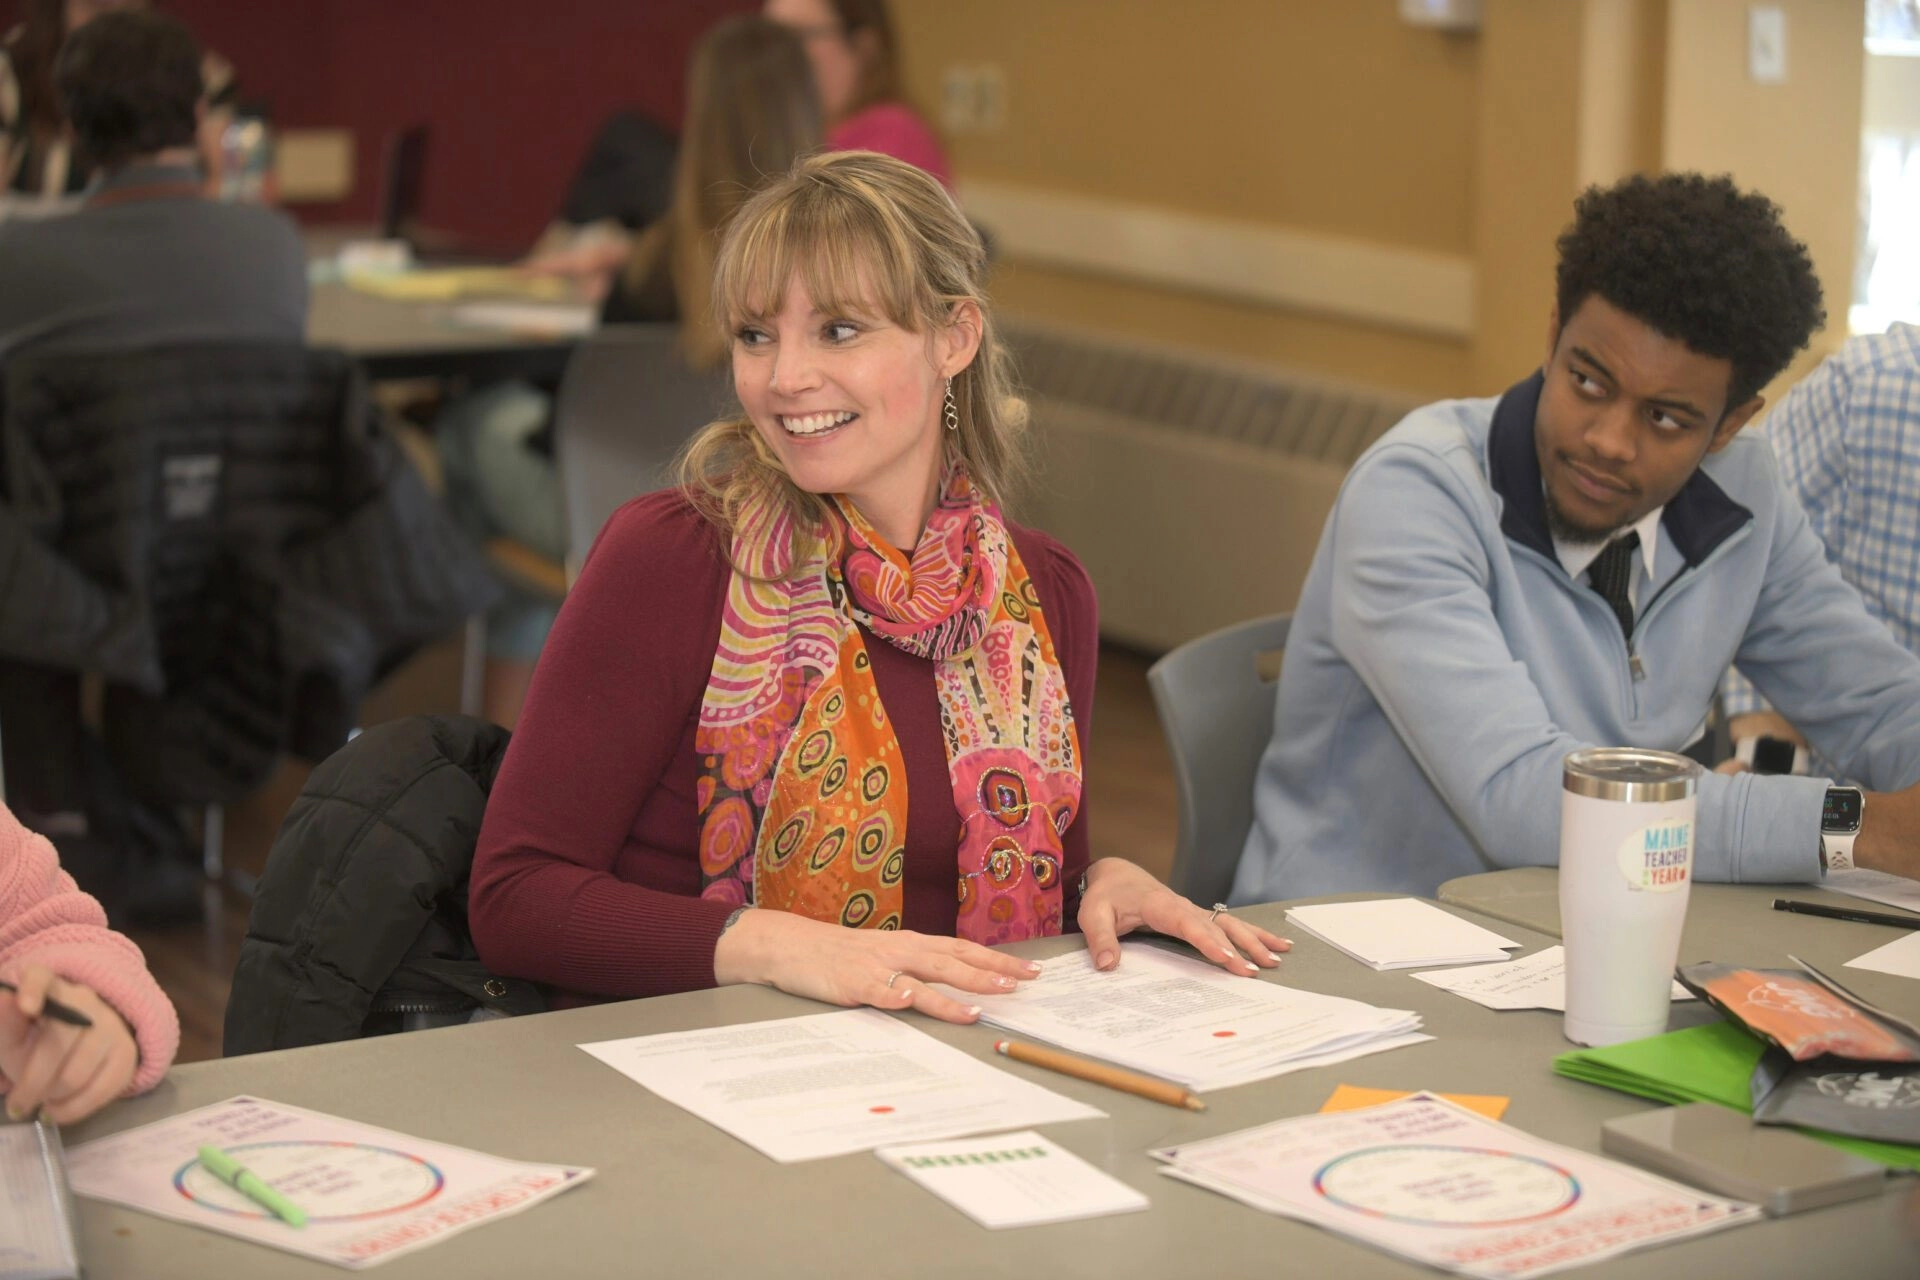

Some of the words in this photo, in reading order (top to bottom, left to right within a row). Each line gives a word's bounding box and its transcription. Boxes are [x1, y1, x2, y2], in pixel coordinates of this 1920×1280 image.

[1644, 824, 1689, 850] MAINE
[1644, 848, 1687, 868] TEACHER
[1651, 866, 1678, 885] YEAR
